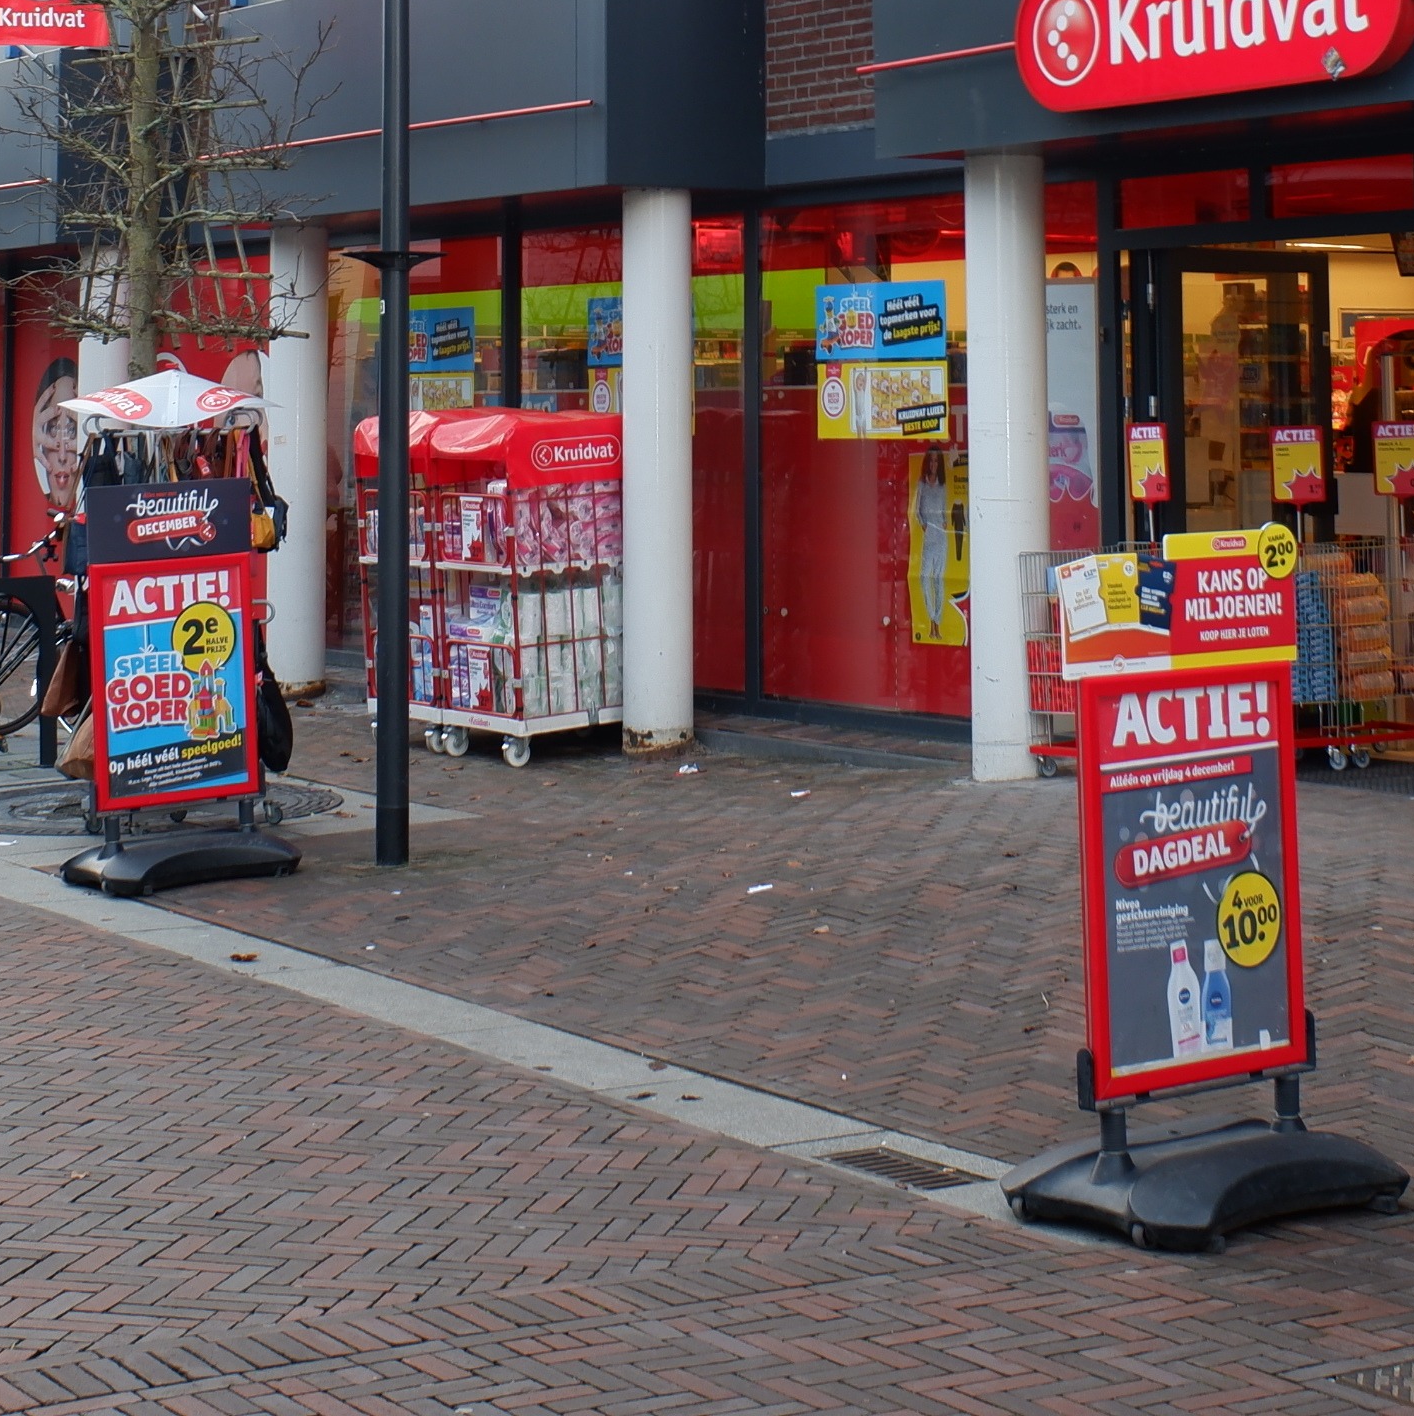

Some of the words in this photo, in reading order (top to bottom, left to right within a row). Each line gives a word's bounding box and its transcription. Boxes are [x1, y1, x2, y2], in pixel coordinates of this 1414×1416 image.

[879, 309, 919, 326] topmerken
[919, 307, 937, 318] voor
[1066, 305, 1078, 315] en
[892, 324, 919, 339] laagste
[903, 420, 921, 432] BESTE
[922, 419, 939, 430] KOOP
[1131, 426, 1161, 440] ACTIE!
[1275, 429, 1316, 442] ACTIE!
[554, 441, 615, 463] Kruidvat
[126, 488, 219, 518] beautiful
[137, 516, 197, 537] DECEMBER
[1267, 534, 1286, 543] VANAF
[1197, 568, 1244, 594] KANS
[1246, 567, 1268, 590] OP
[109, 569, 231, 617] ACTIE!
[1184, 592, 1283, 621] MILJOENEN!
[182, 617, 218, 656] 2e
[206, 636, 229, 645] HALVE
[1199, 629, 1219, 642] KOOP
[1220, 628, 1236, 640] HIER
[1236, 628, 1246, 638] JE
[1247, 626, 1269, 638] LOTEN
[206, 645, 227, 654] PRIJS
[116, 653, 182, 677] SPEEL
[108, 673, 192, 705] GOED
[110, 699, 188, 729] KOPER
[1112, 681, 1271, 747] ACTIE!
[109, 760, 125, 775] Op
[127, 752, 153, 770] héél
[154, 746, 180, 764] véél
[181, 734, 242, 760] speelgoed!
[1110, 774, 1139, 788] Alléén
[1140, 773, 1152, 786] op
[1153, 768, 1184, 784] vrijdag
[1184, 767, 1191, 778] 4
[1191, 760, 1235, 777] december!
[1139, 782, 1267, 836] beautiful
[1132, 830, 1231, 877] DAGDEAL
[1115, 897, 1140, 912] Nivea
[1231, 890, 1243, 910] 4
[1243, 893, 1264, 908] VOOR
[1116, 904, 1189, 926] gezichtsreiniging
